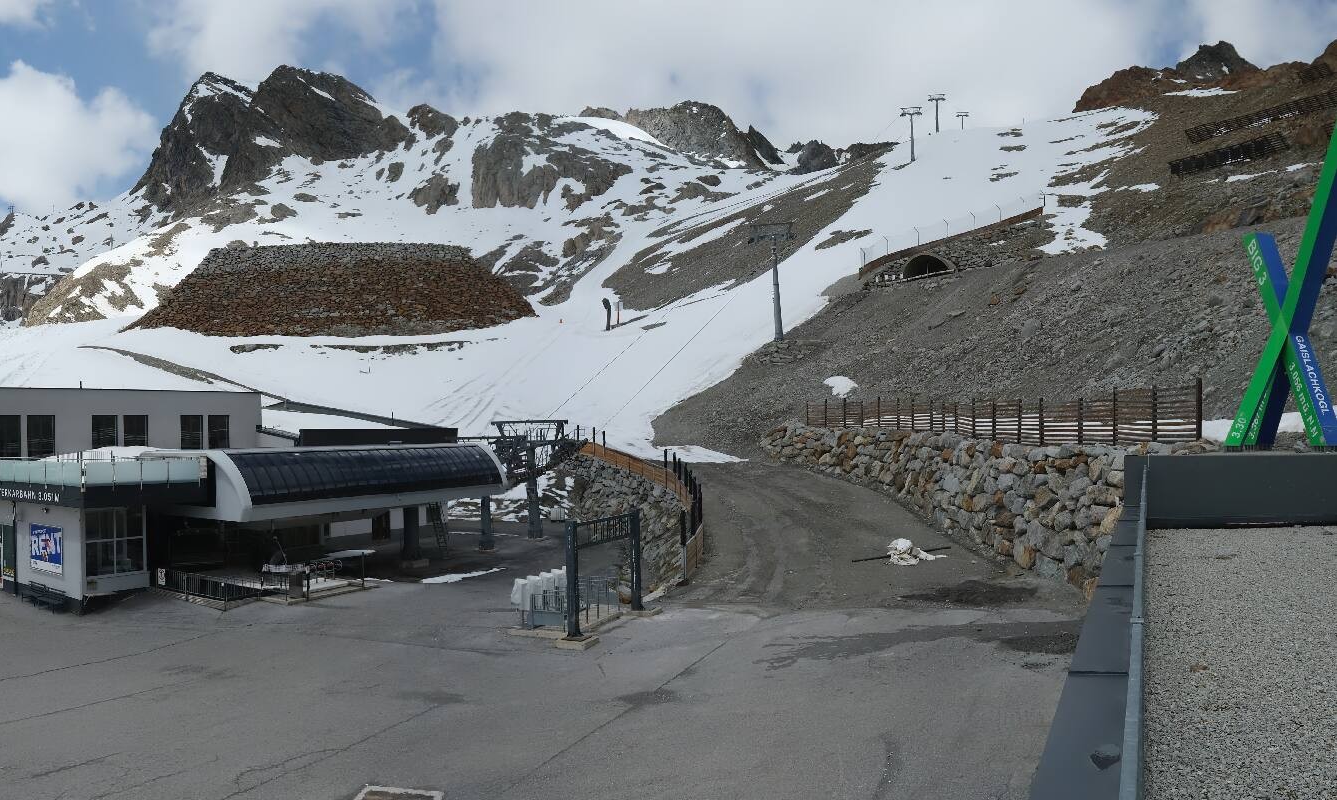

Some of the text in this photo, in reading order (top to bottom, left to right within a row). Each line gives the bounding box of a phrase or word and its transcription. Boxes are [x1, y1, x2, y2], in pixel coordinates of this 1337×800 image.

[1248, 239, 1267, 286] BIG 3
[1295, 335, 1330, 416] GAISLACHKOGL
